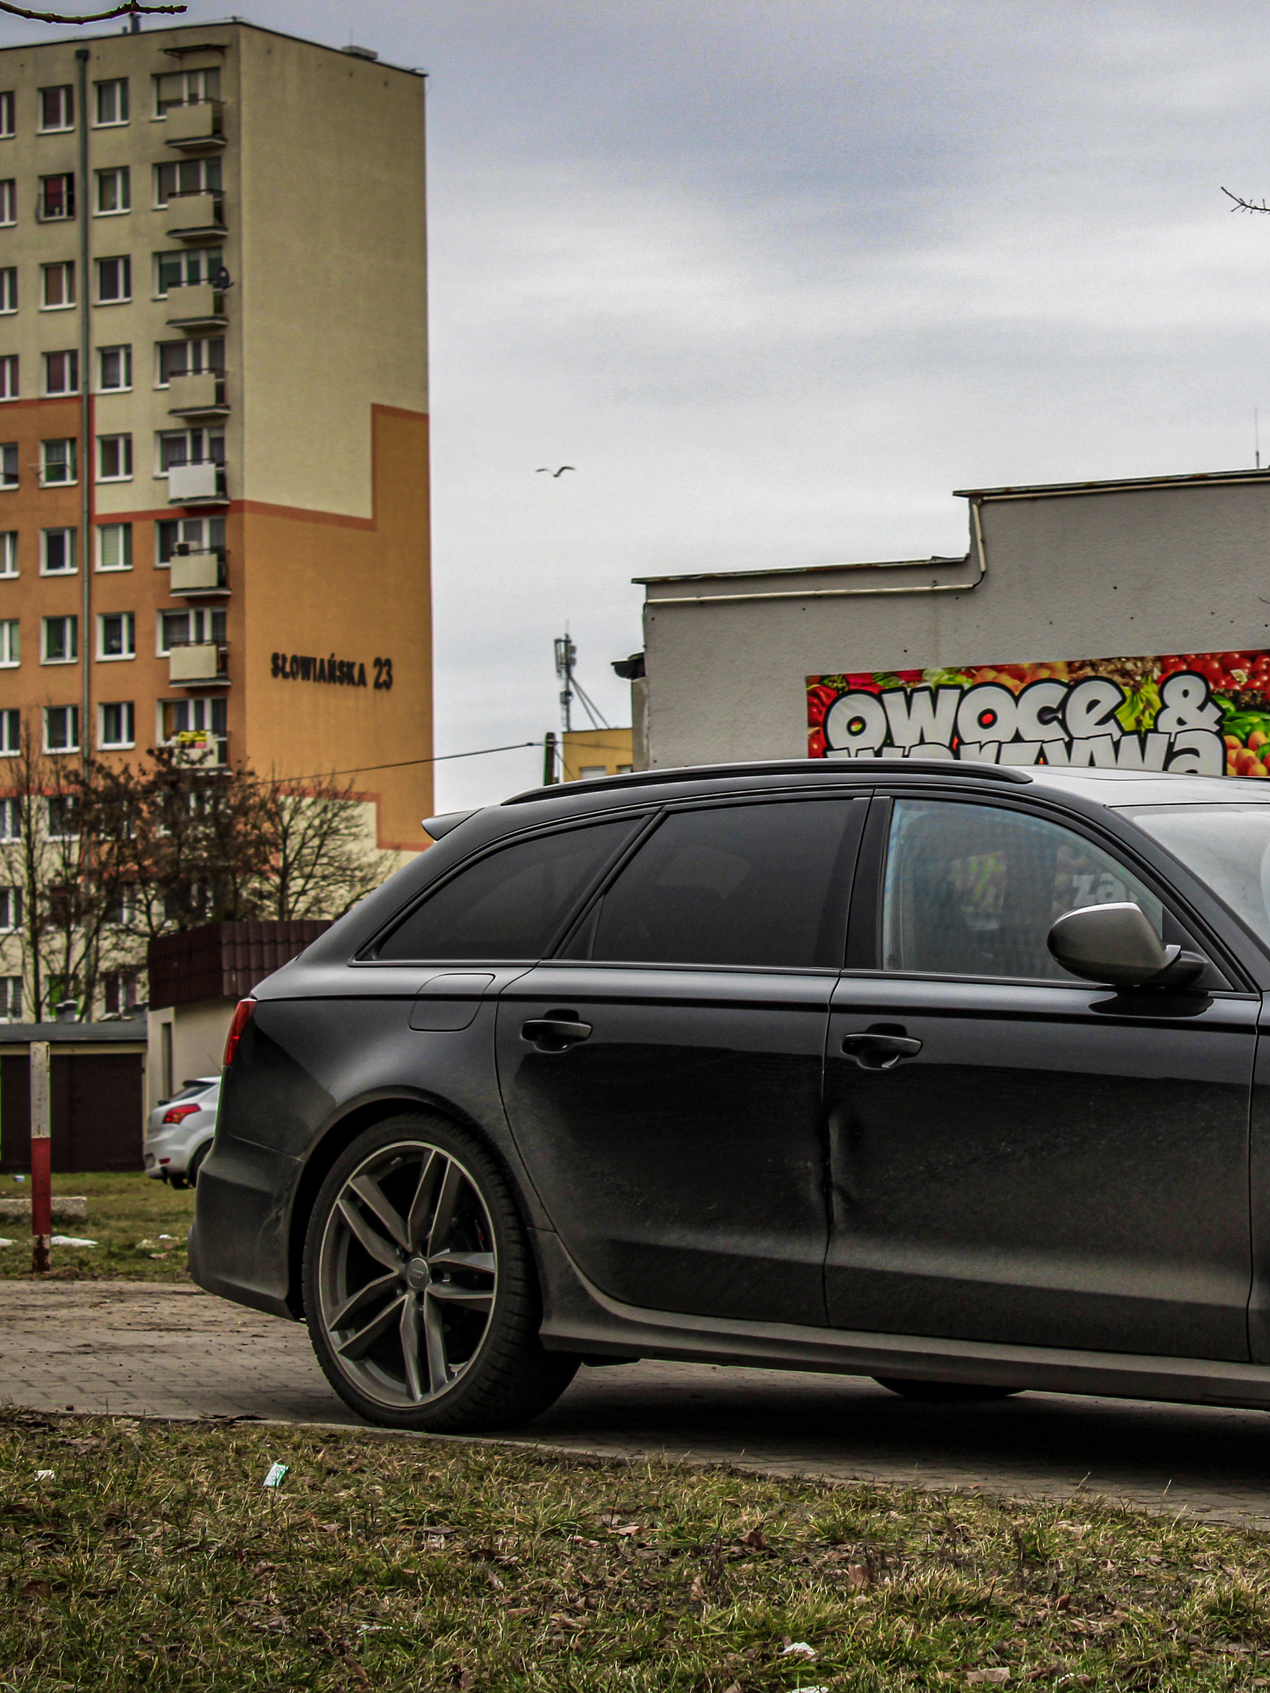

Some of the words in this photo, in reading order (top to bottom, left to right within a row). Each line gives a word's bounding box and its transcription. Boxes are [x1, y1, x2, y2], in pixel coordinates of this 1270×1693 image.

[271, 652, 368, 688] SŁOWIAŃSKA
[373, 656, 393, 691] 23
[1154, 670, 1226, 738] &
